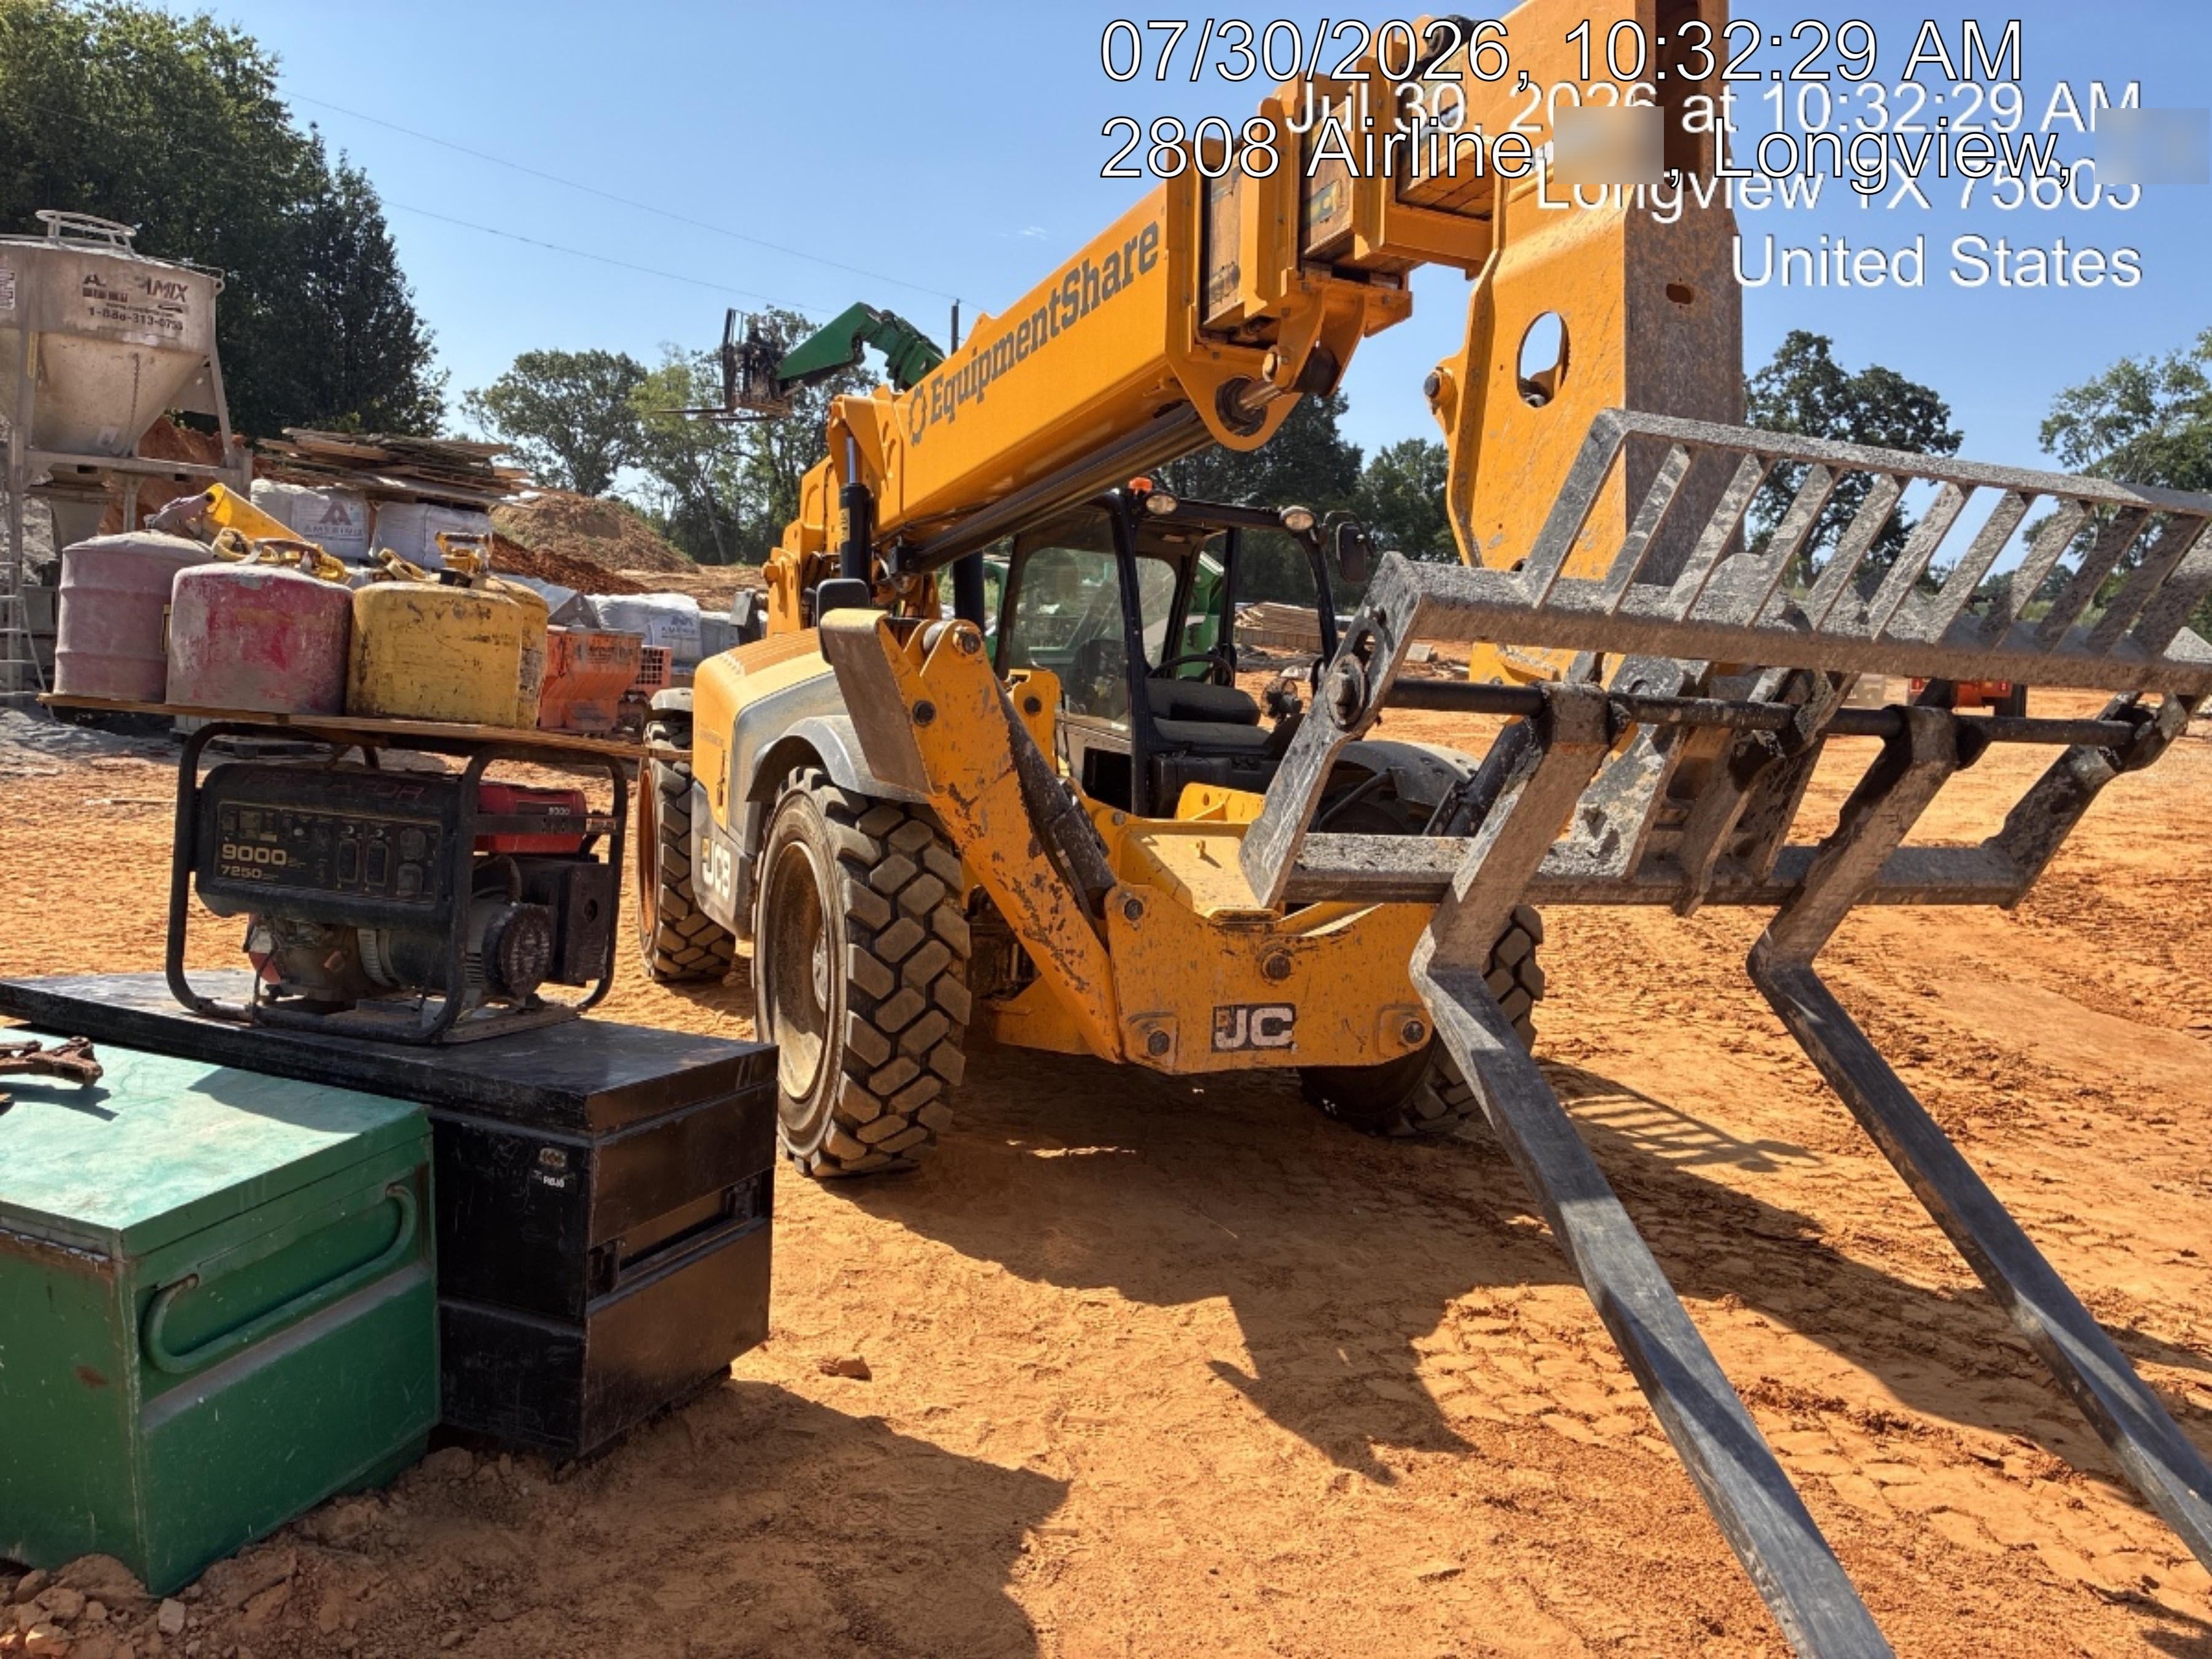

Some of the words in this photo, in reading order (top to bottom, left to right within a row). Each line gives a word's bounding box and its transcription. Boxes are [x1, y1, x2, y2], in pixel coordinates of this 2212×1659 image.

[930, 221, 1159, 425] EquipmentShare
[221, 843, 288, 866] 9000
[220, 864, 263, 879] 7250
